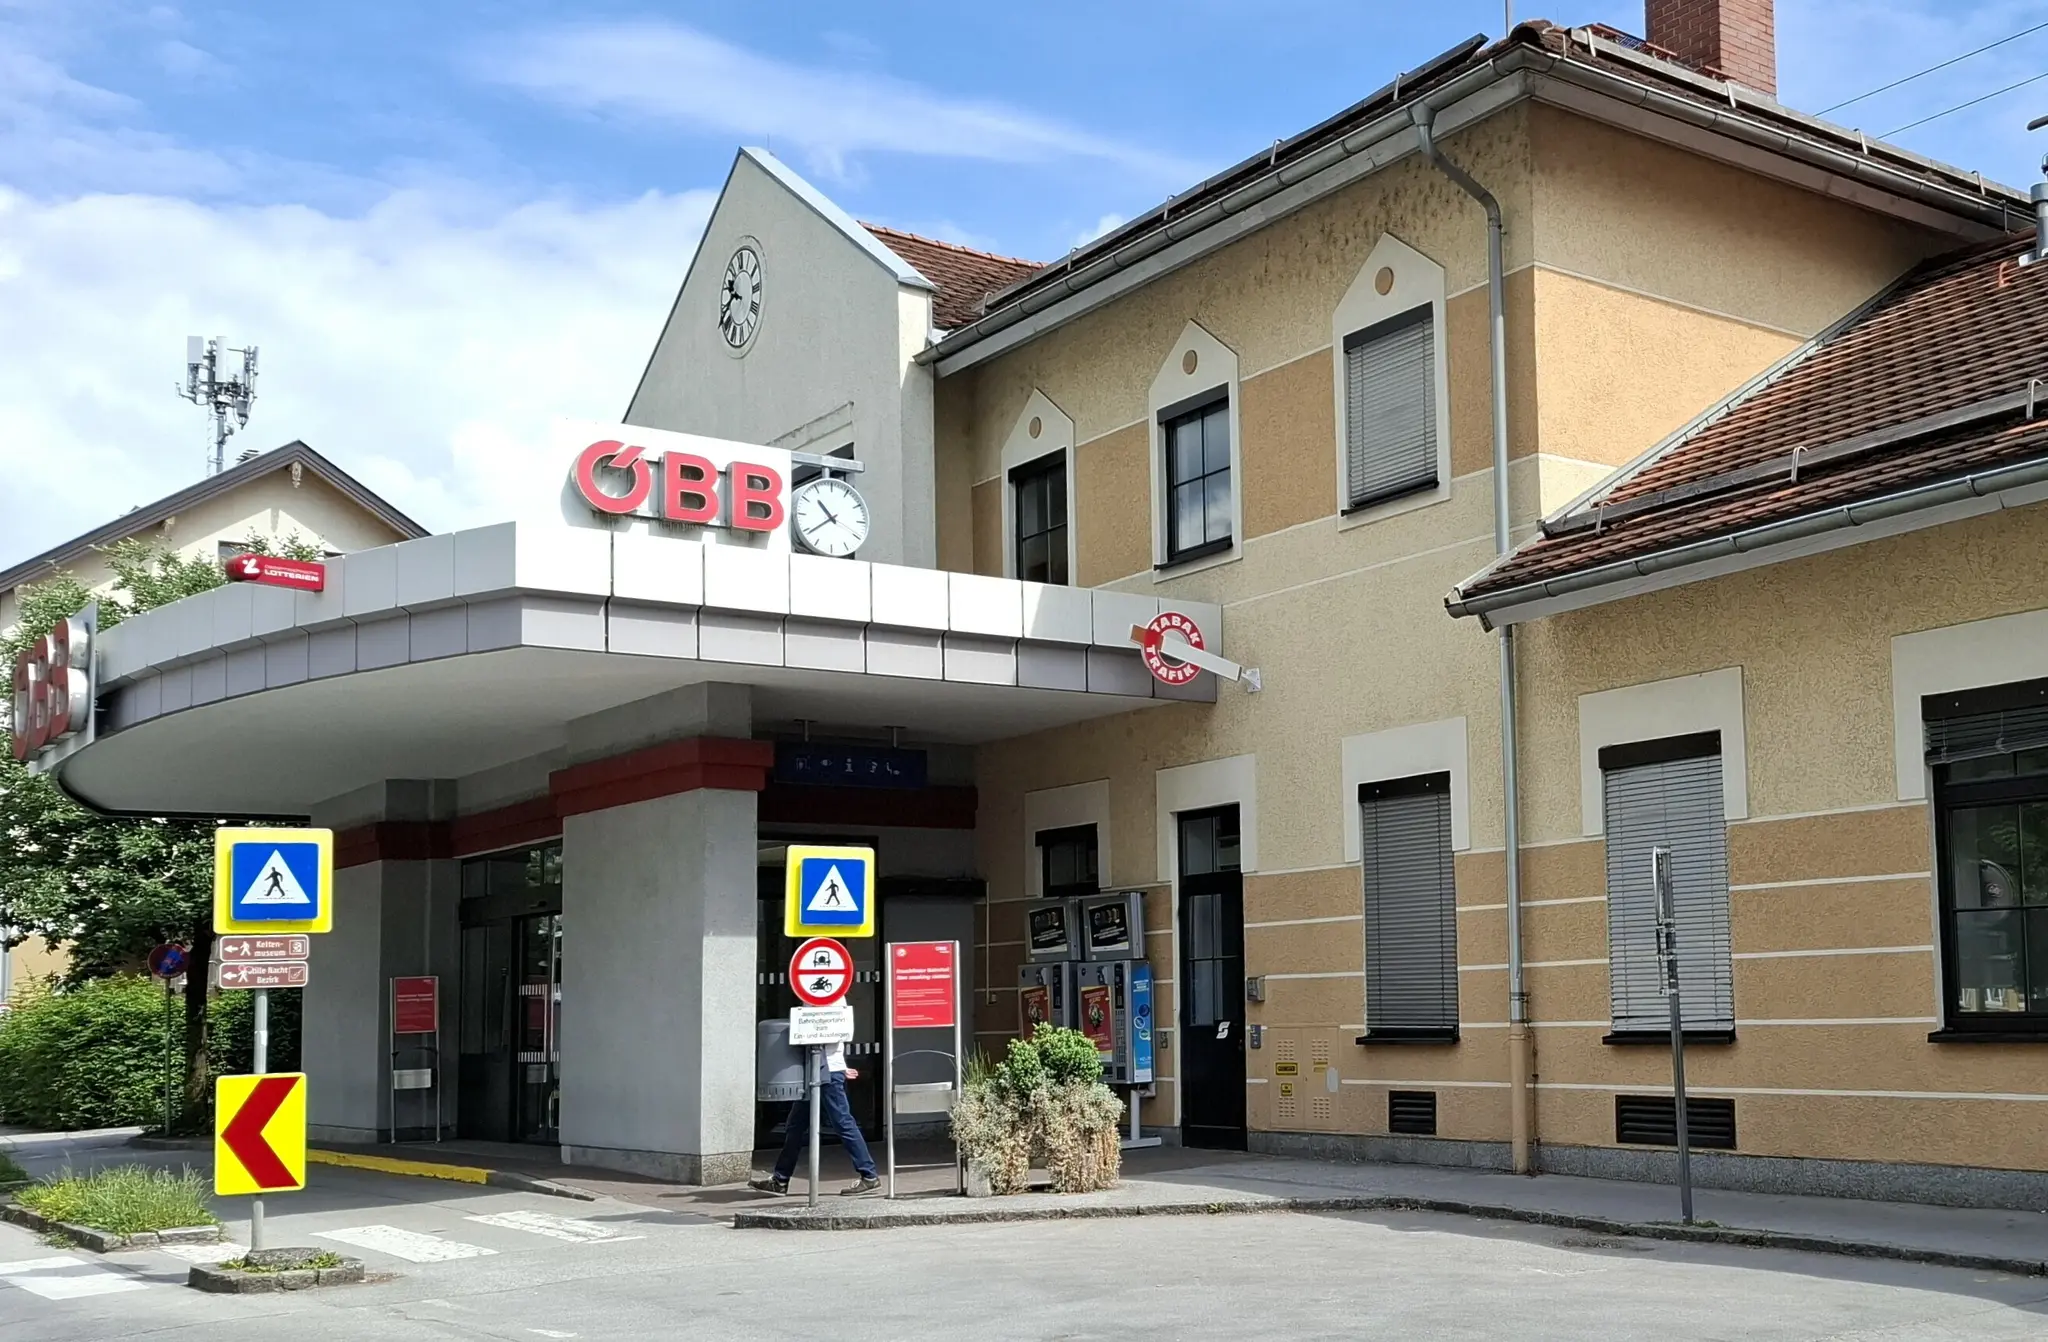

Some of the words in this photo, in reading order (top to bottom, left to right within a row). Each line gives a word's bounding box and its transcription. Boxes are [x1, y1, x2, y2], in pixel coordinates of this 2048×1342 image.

[575, 439, 785, 532] ÖBB
[264, 568, 320, 582] LOTTERIEN
[1150, 615, 1201, 645] TABAK
[1146, 644, 1195, 681] TRAFIK
[256, 940, 284, 948] Kelten-
[267, 966, 288, 974] Nacht
[257, 976, 280, 984] Bezirk
